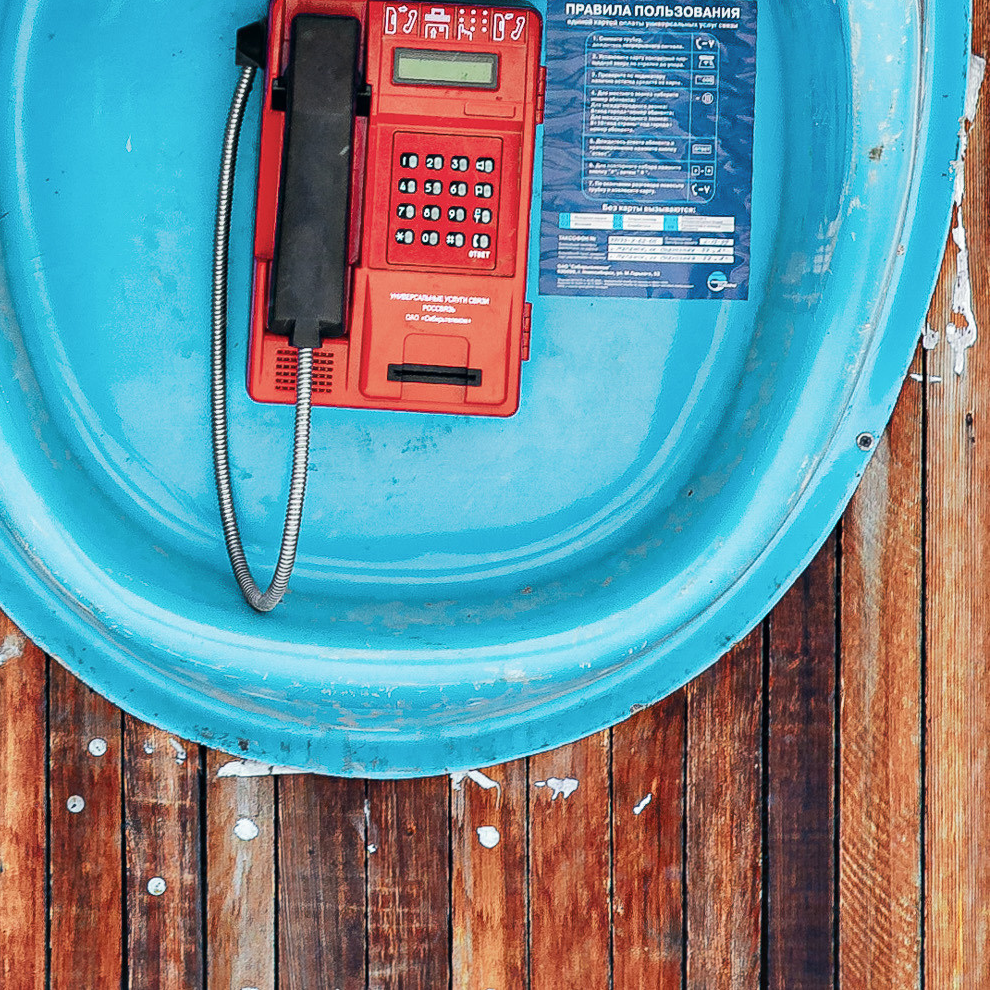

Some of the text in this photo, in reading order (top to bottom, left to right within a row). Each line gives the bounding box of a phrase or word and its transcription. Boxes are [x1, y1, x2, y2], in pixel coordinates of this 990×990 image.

[565, 3, 741, 19] ПРАВИЛА ПОЛЬЗОВАНИЯ
[602, 203, 617, 212] Без
[618, 204, 642, 213] карты
